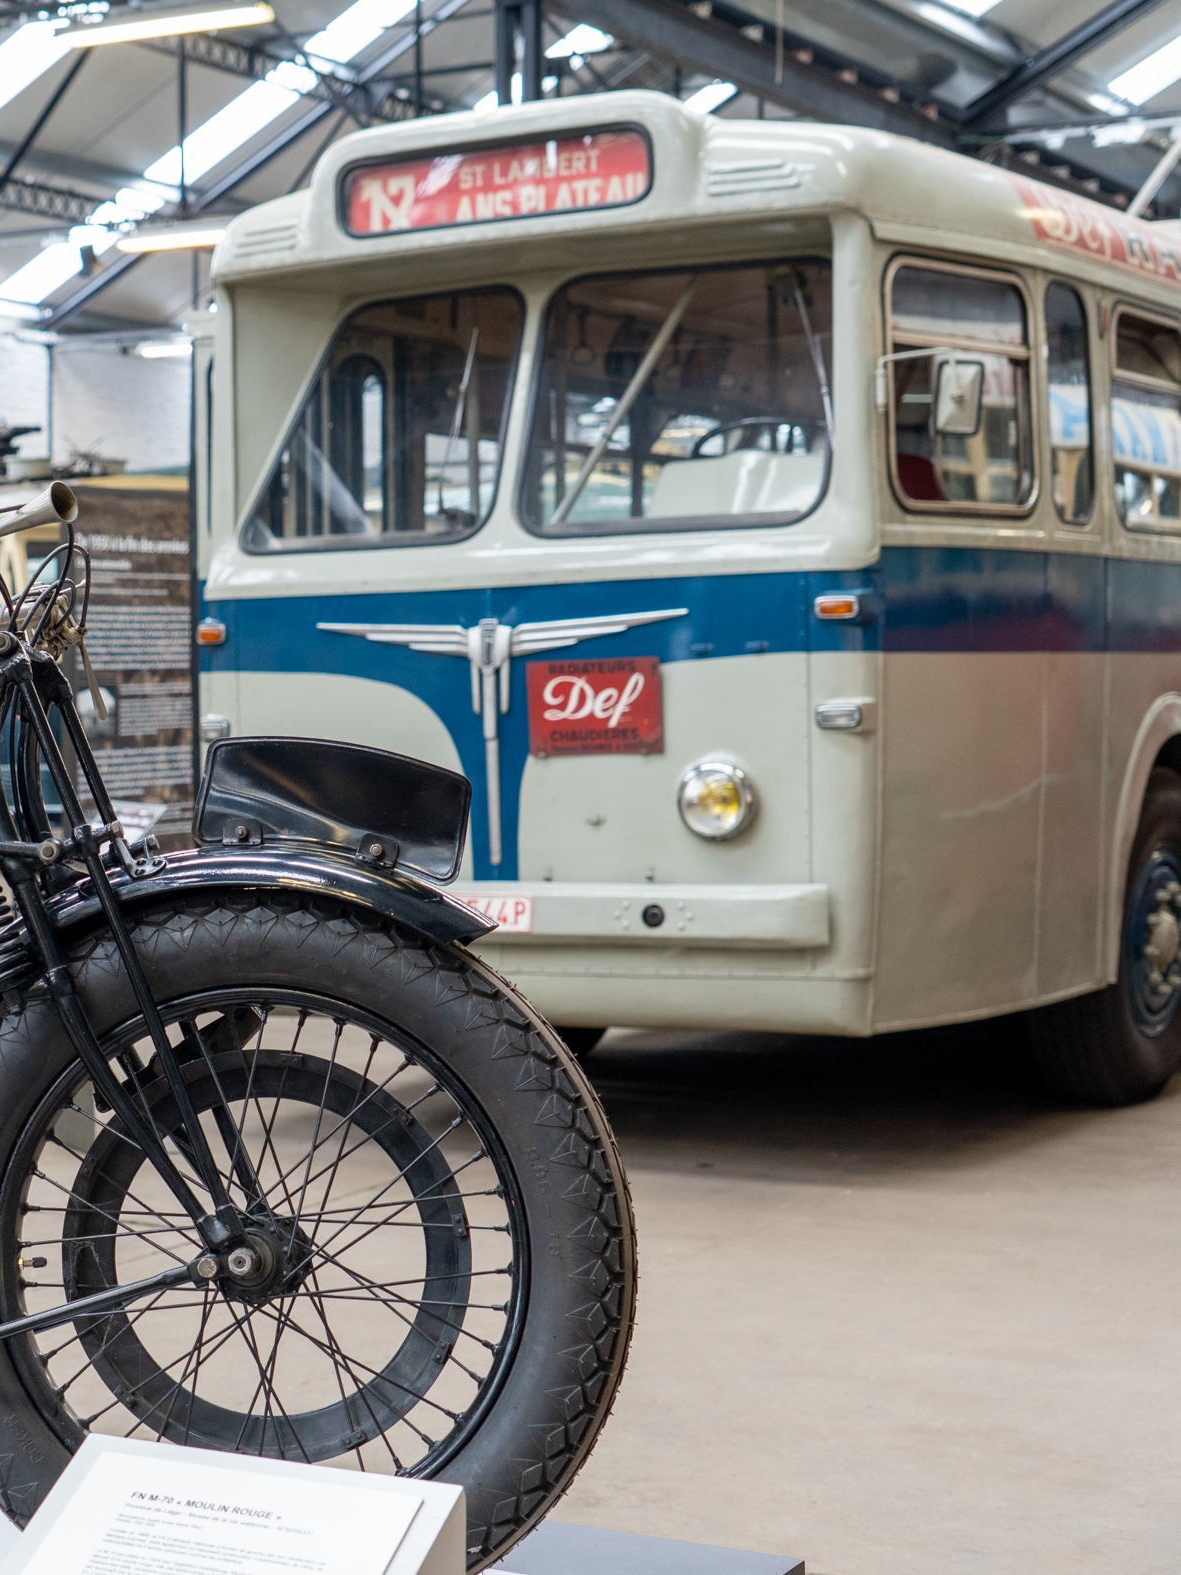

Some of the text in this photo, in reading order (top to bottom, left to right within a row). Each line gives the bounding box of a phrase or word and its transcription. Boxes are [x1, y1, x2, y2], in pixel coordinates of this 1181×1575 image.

[459, 167, 486, 189] ST
[493, 149, 601, 184] LAMBERT
[456, 171, 645, 222] ANS PLATEAU
[548, 660, 636, 674] RADIATEURS
[543, 671, 645, 728] Def
[131, 1491, 147, 1500] FN
[148, 1494, 174, 1504] M-70
[185, 1500, 230, 1513] MOULIN
[231, 1506, 273, 1520] ROUGE
